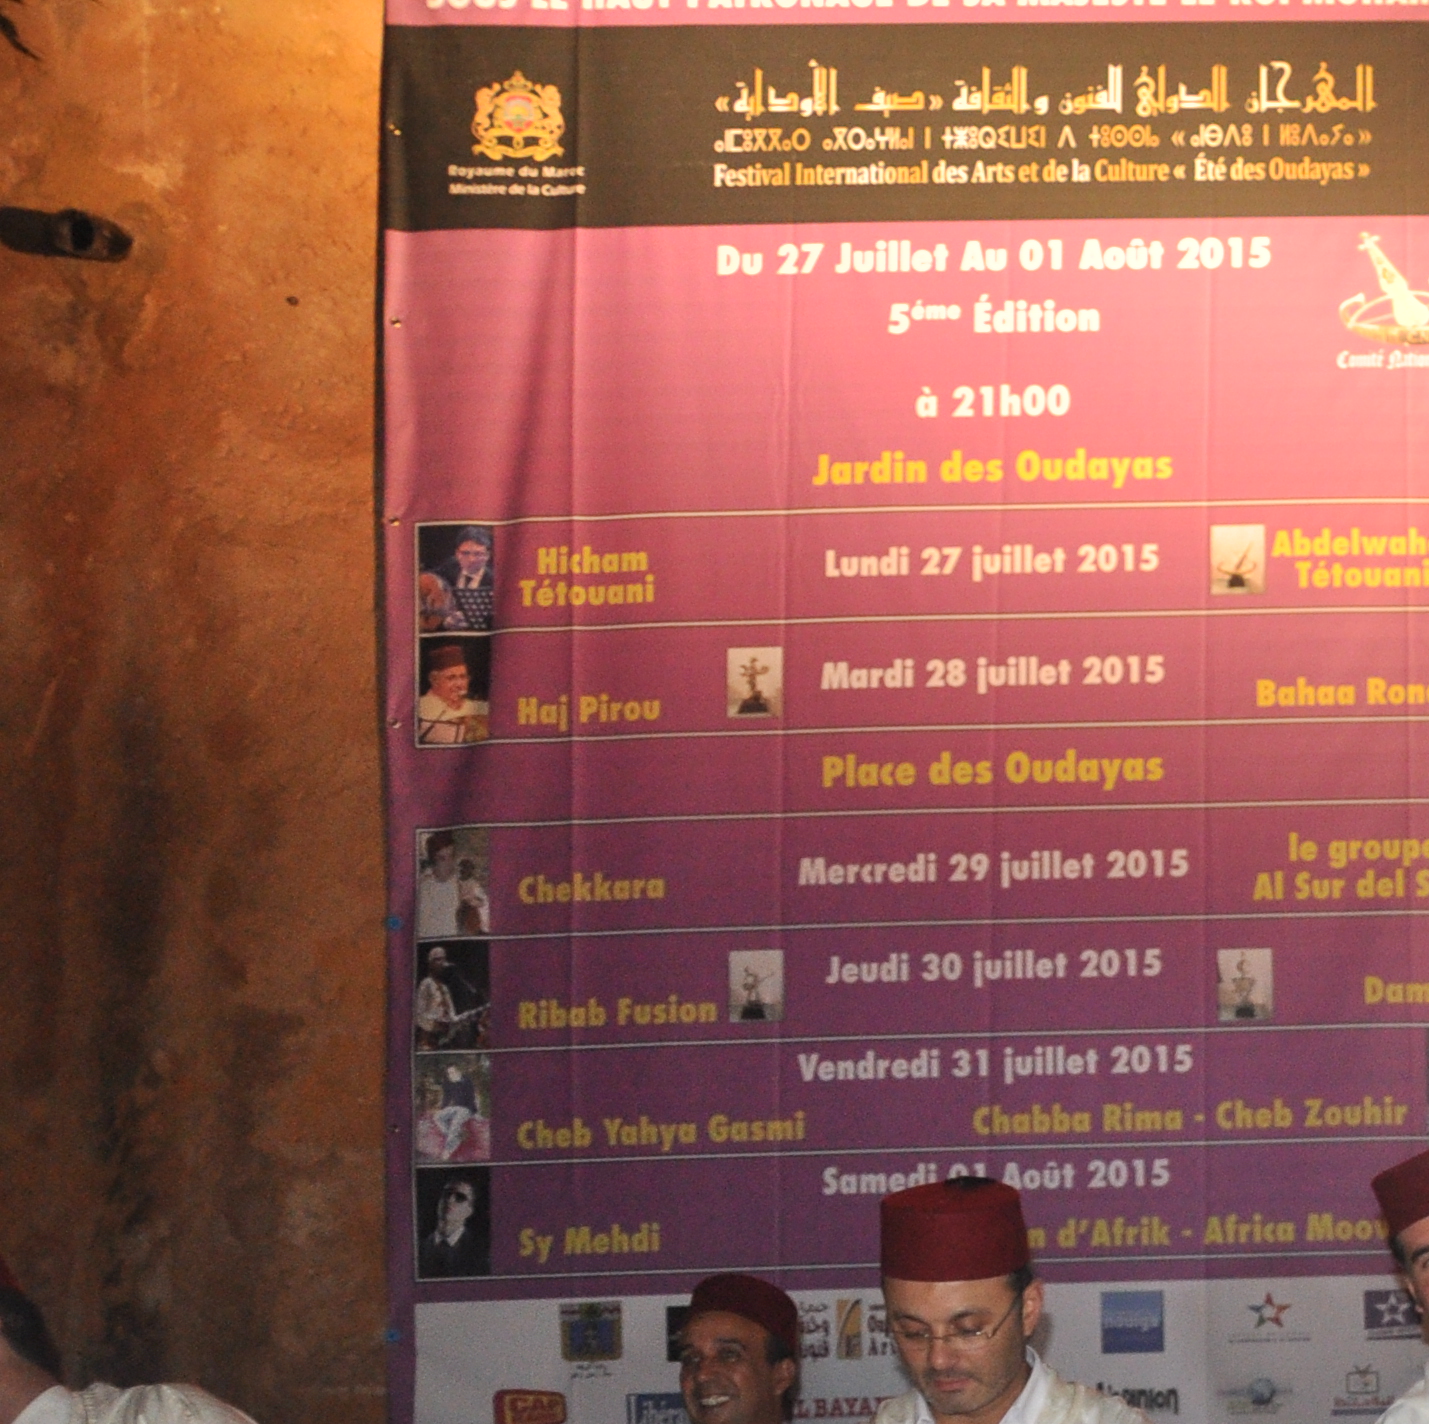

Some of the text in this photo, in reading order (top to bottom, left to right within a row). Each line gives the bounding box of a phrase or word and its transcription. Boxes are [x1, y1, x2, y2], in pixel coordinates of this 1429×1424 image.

[1133, 65, 1231, 117] الدولي
[1245, 60, 1378, 114] المهرجان
[448, 164, 585, 179] Royaume du Maroc
[713, 162, 790, 187] Festival
[795, 160, 928, 186] International
[932, 160, 968, 184] des
[971, 160, 1014, 183] Arts
[1017, 163, 1038, 183] et
[1042, 158, 1069, 182] de
[1072, 158, 1091, 182] la
[1094, 157, 1170, 182] Culture
[1194, 151, 1227, 181] Été
[1230, 156, 1266, 181] des
[1268, 156, 1354, 186] Oudayas
[448, 183, 586, 196] Ministère de la Culture
[717, 236, 1272, 275] Du 27 Juillet Au 01 Août 2015
[973, 293, 1101, 333] Édition
[1336, 348, 1384, 369] Comité
[915, 383, 1071, 417] à 21h00
[812, 448, 1174, 489] Jardin des Oudayas
[537, 546, 648, 575] Hicham
[825, 543, 1160, 582] Lundi 27 juillet 2015
[519, 574, 655, 607] Tétouani
[821, 655, 1165, 695] Mardi 28 juillet 2015
[1257, 677, 1356, 708] Bahaa
[517, 693, 660, 730] Haj Pirou
[823, 750, 1164, 790] Place des Oudayas
[1289, 832, 1318, 862] le
[798, 849, 1189, 889] Mercredi 29 juillet 2015
[1254, 870, 1286, 900] Al
[1294, 873, 1345, 900] Sur
[1356, 870, 1403, 898] del
[518, 872, 666, 904] Chekkara
[825, 947, 1162, 987] Jeudi 30 juillet 2015
[519, 994, 718, 1030] Ribab Fusion
[799, 1044, 1193, 1083] Vendredi 31 juillet 2015
[517, 1111, 805, 1151] Cheb Yahya Gasmi
[973, 1103, 1091, 1135] Chabba
[1103, 1102, 1182, 1132] Rima
[1216, 1098, 1292, 1128] Cheb
[1304, 1095, 1407, 1124] Zouhir
[822, 1163, 937, 1195] Samedi
[1002, 1161, 1075, 1190] Août
[1087, 1158, 1170, 1188] 2015
[518, 1223, 660, 1262] Sy Mehdi
[1204, 1210, 1295, 1243] Africa
